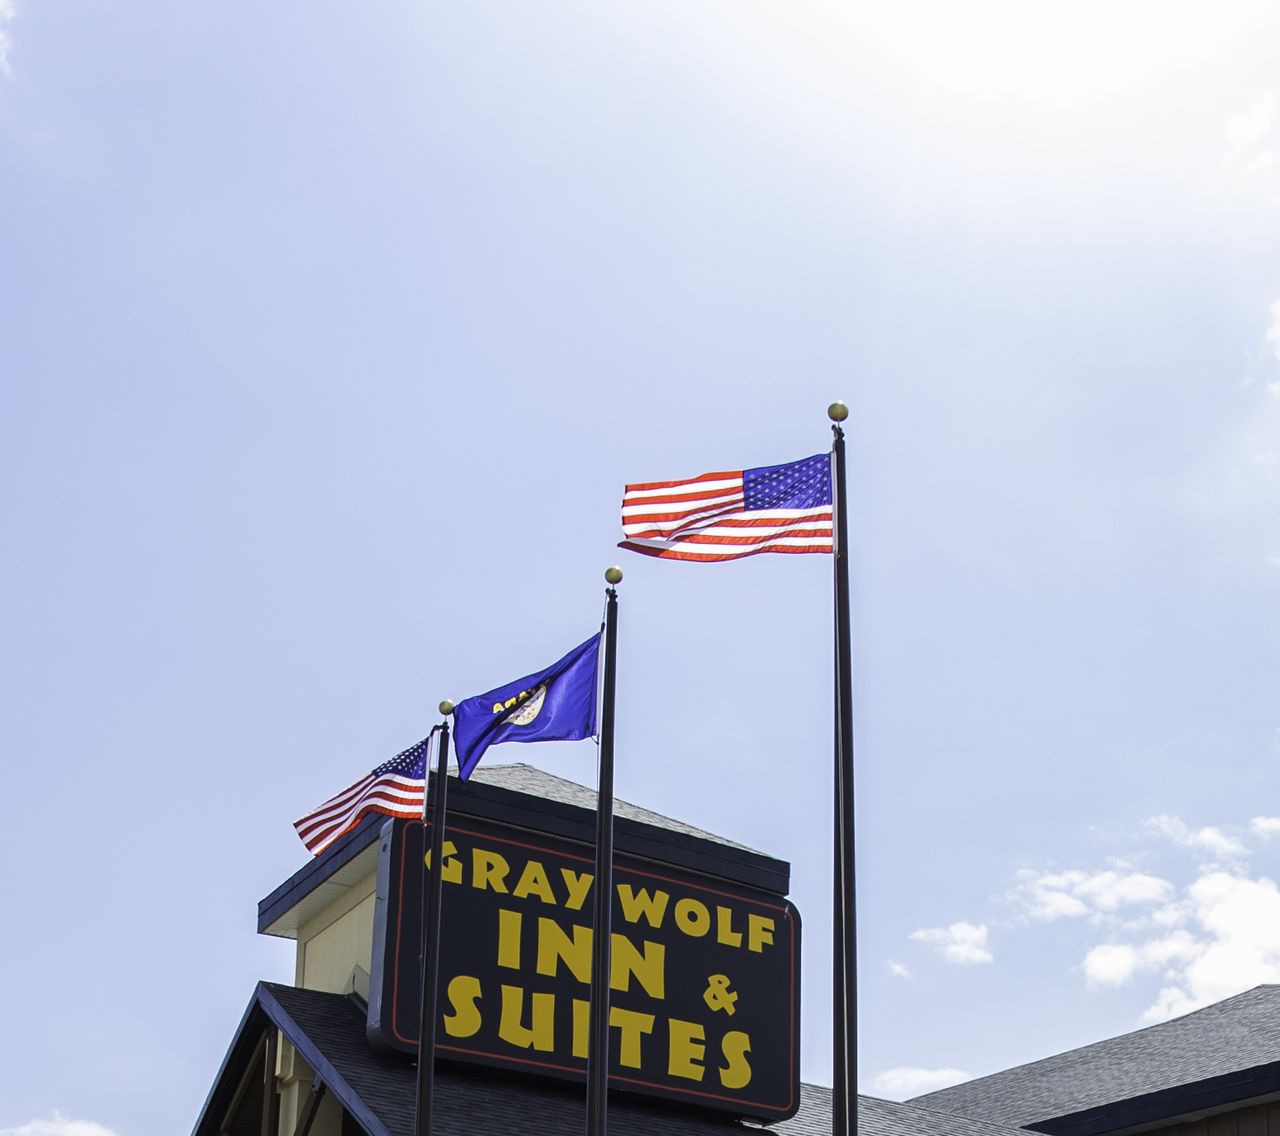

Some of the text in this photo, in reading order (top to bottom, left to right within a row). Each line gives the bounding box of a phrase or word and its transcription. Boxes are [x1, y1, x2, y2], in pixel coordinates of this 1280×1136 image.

[425, 840, 776, 953] GRAY WOLF
[497, 908, 739, 1016] INN &
[443, 975, 752, 1090] SUITES
